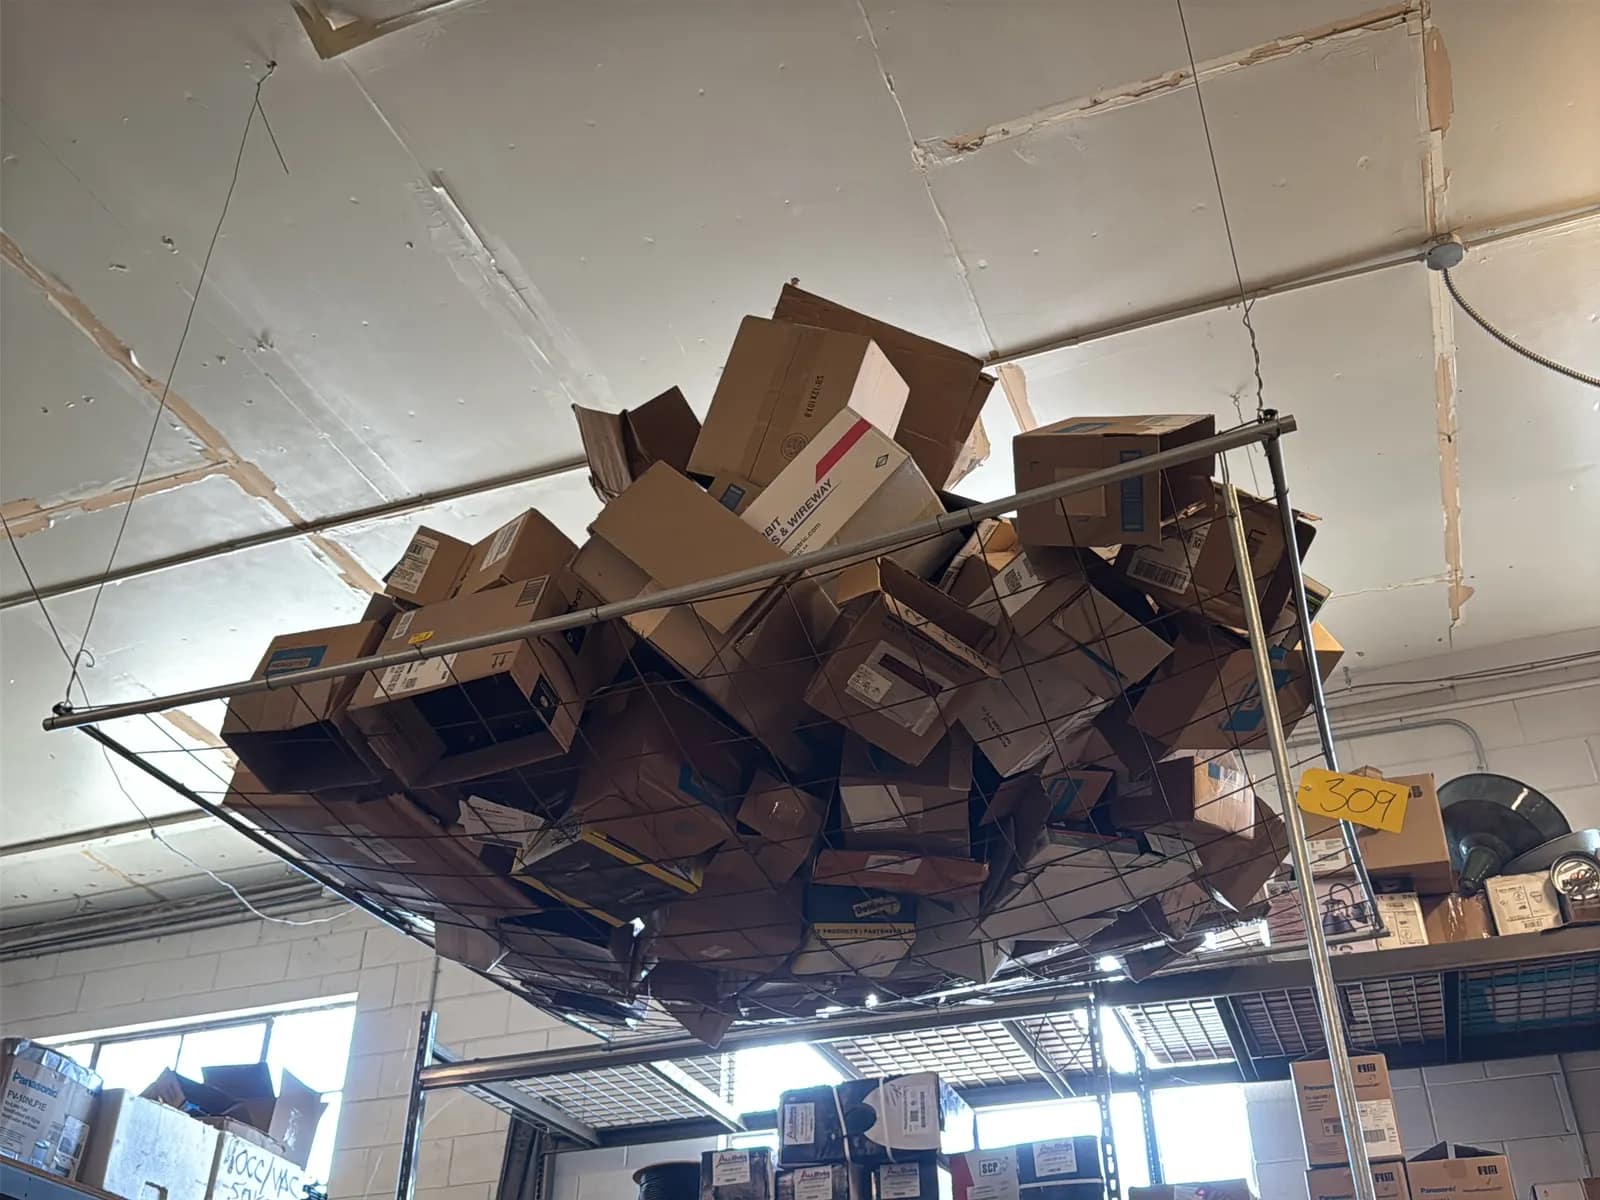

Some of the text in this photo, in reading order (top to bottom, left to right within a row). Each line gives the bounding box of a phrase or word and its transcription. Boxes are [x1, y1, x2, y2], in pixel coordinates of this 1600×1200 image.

[780, 527, 789, 537] &
[786, 478, 833, 528] WIREWAY
[1320, 777, 1397, 824] 309
[12, 1068, 59, 1098] Panasonic
[981, 1163, 999, 1175] SCP
